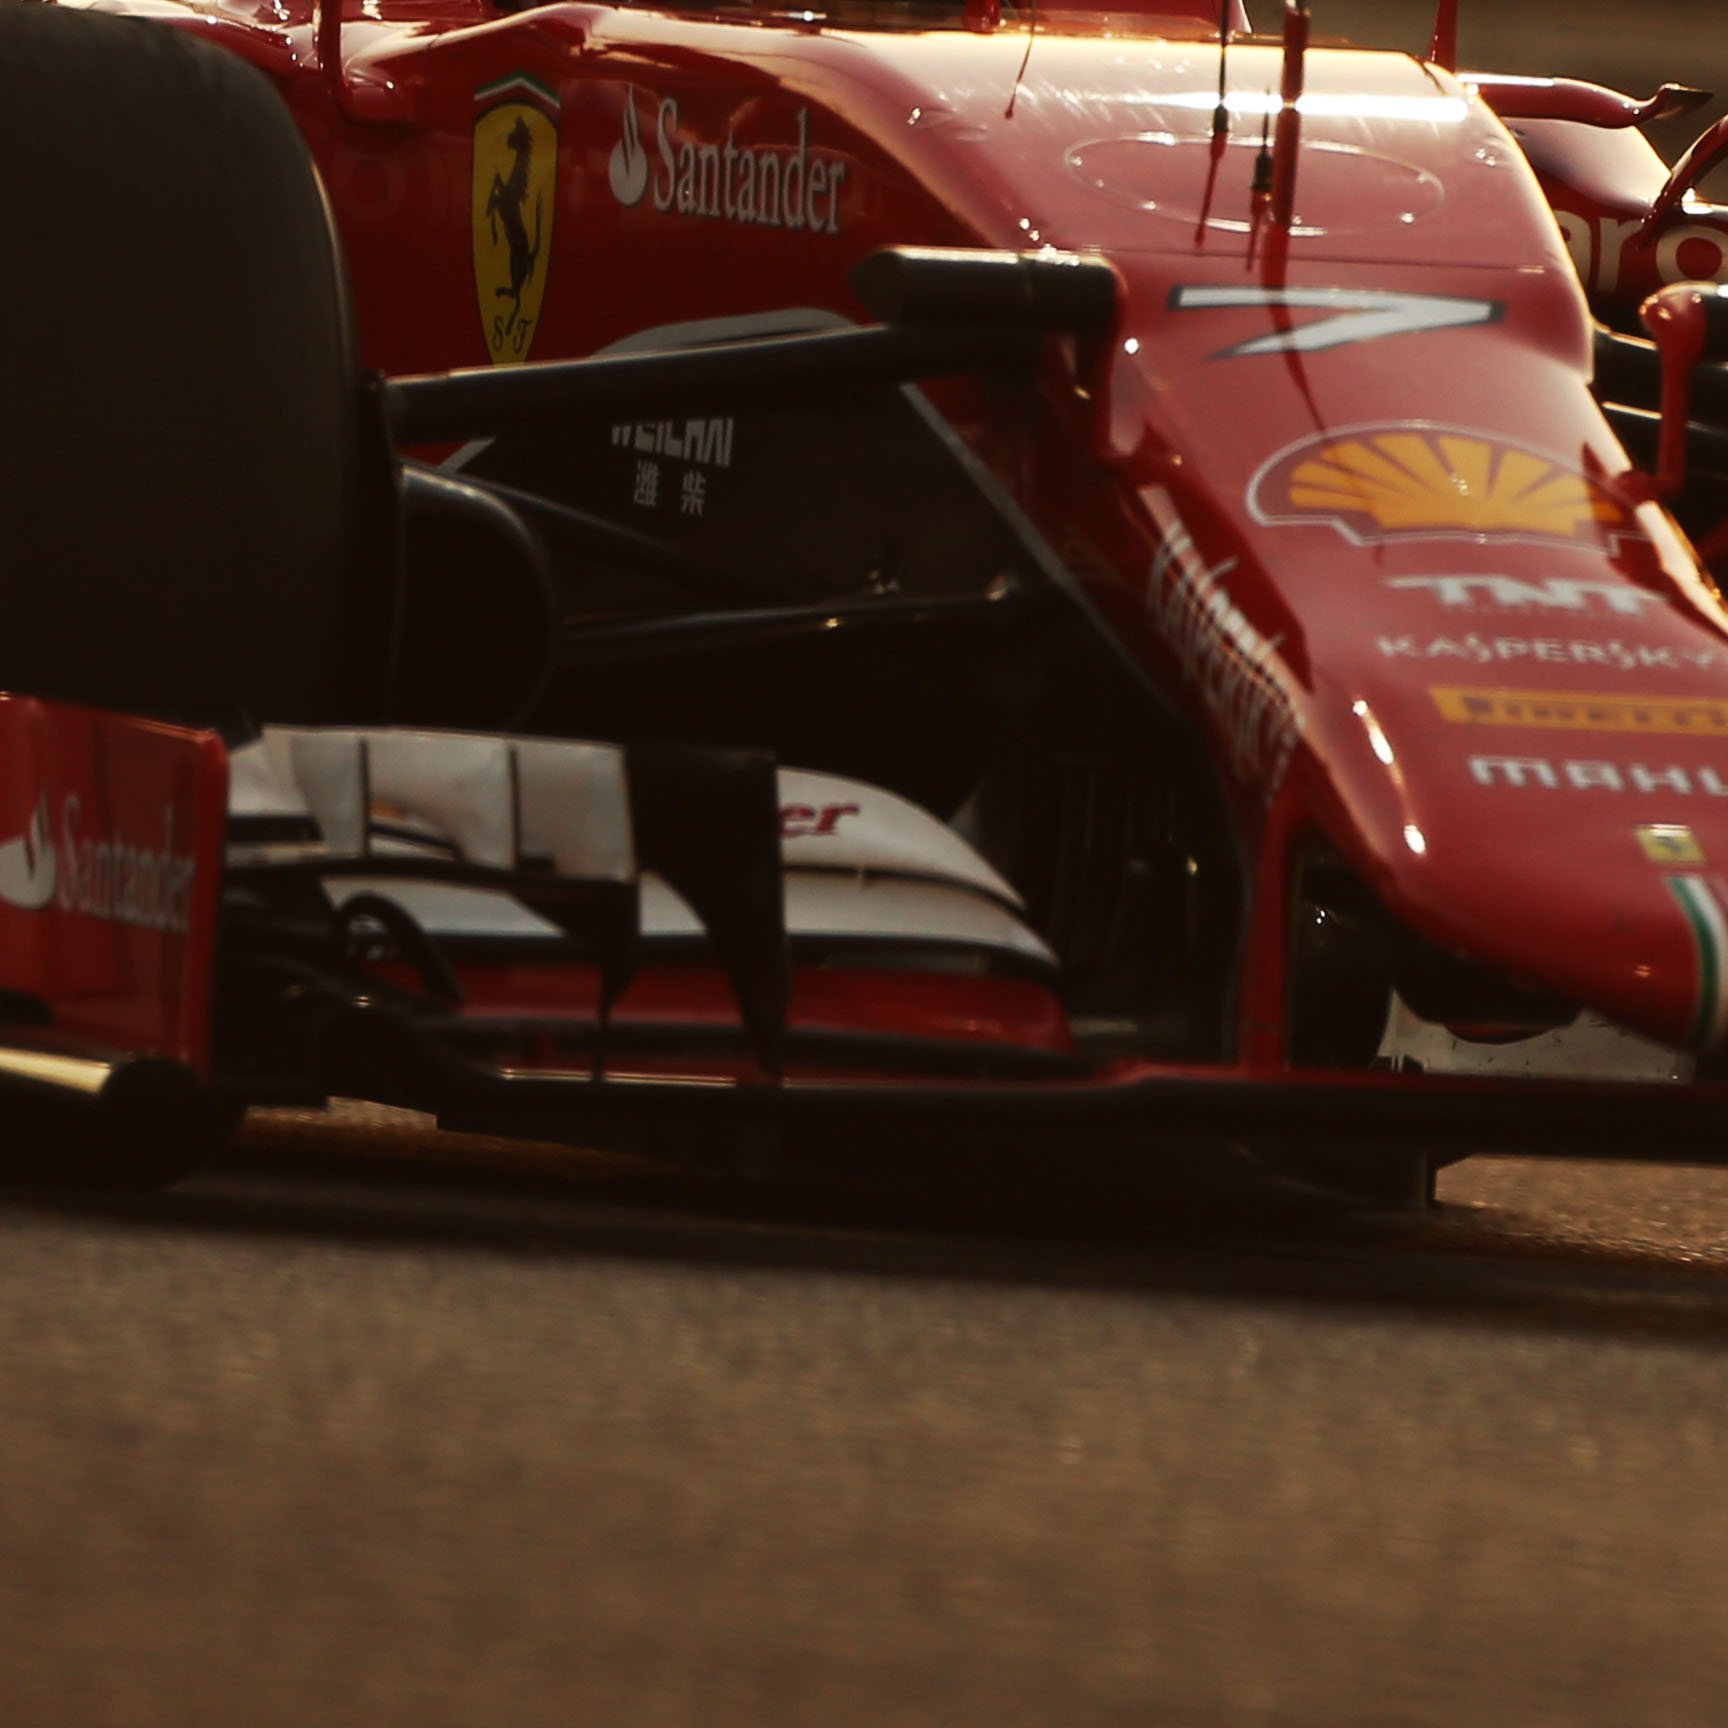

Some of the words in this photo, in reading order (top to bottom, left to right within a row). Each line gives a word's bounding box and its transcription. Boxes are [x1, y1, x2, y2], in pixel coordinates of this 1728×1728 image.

[653, 96, 846, 235] Santander
[1167, 283, 1503, 360] 7
[1385, 574, 1672, 617] TNT
[1376, 631, 1713, 671] KASPERSKY
[57, 788, 196, 935] Santander
